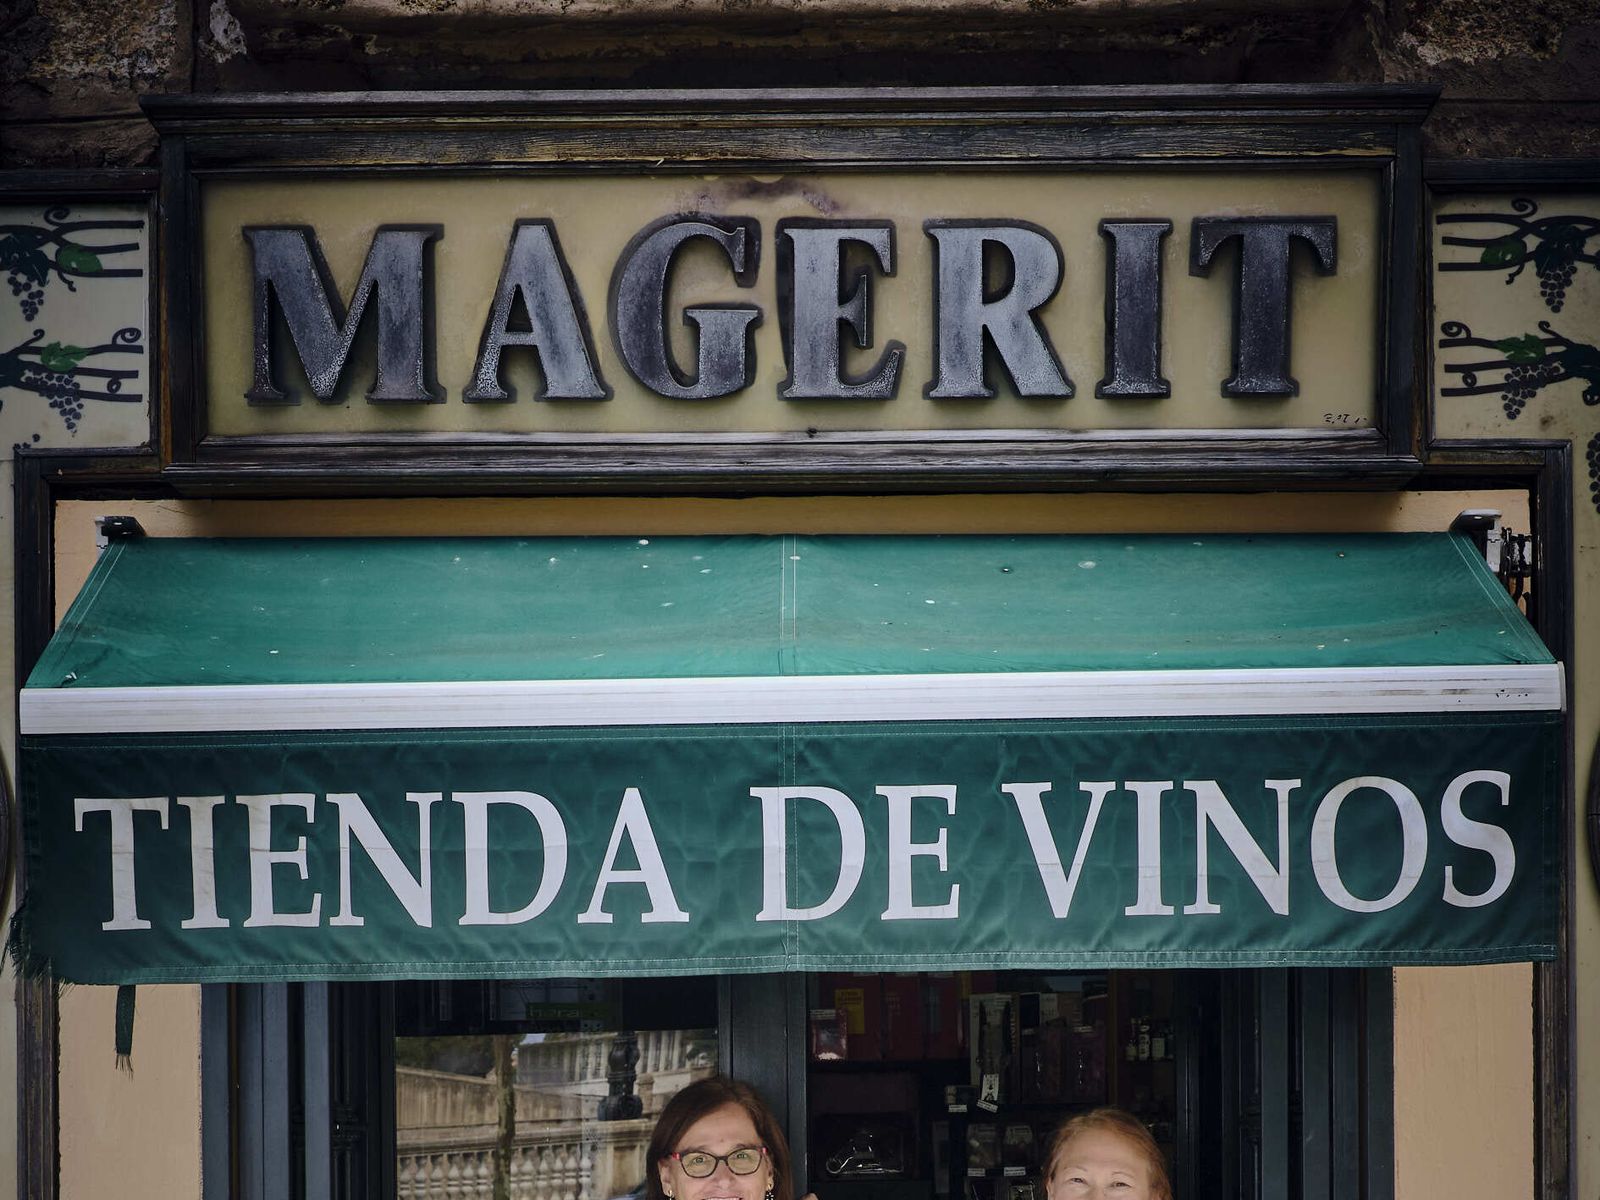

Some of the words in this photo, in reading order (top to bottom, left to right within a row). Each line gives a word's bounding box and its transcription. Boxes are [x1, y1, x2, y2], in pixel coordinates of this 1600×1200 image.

[242, 216, 1337, 405] MAGERIT
[73, 787, 690, 931] TIENDA
[749, 784, 959, 922] DE
[1001, 770, 1517, 920] VINOS
